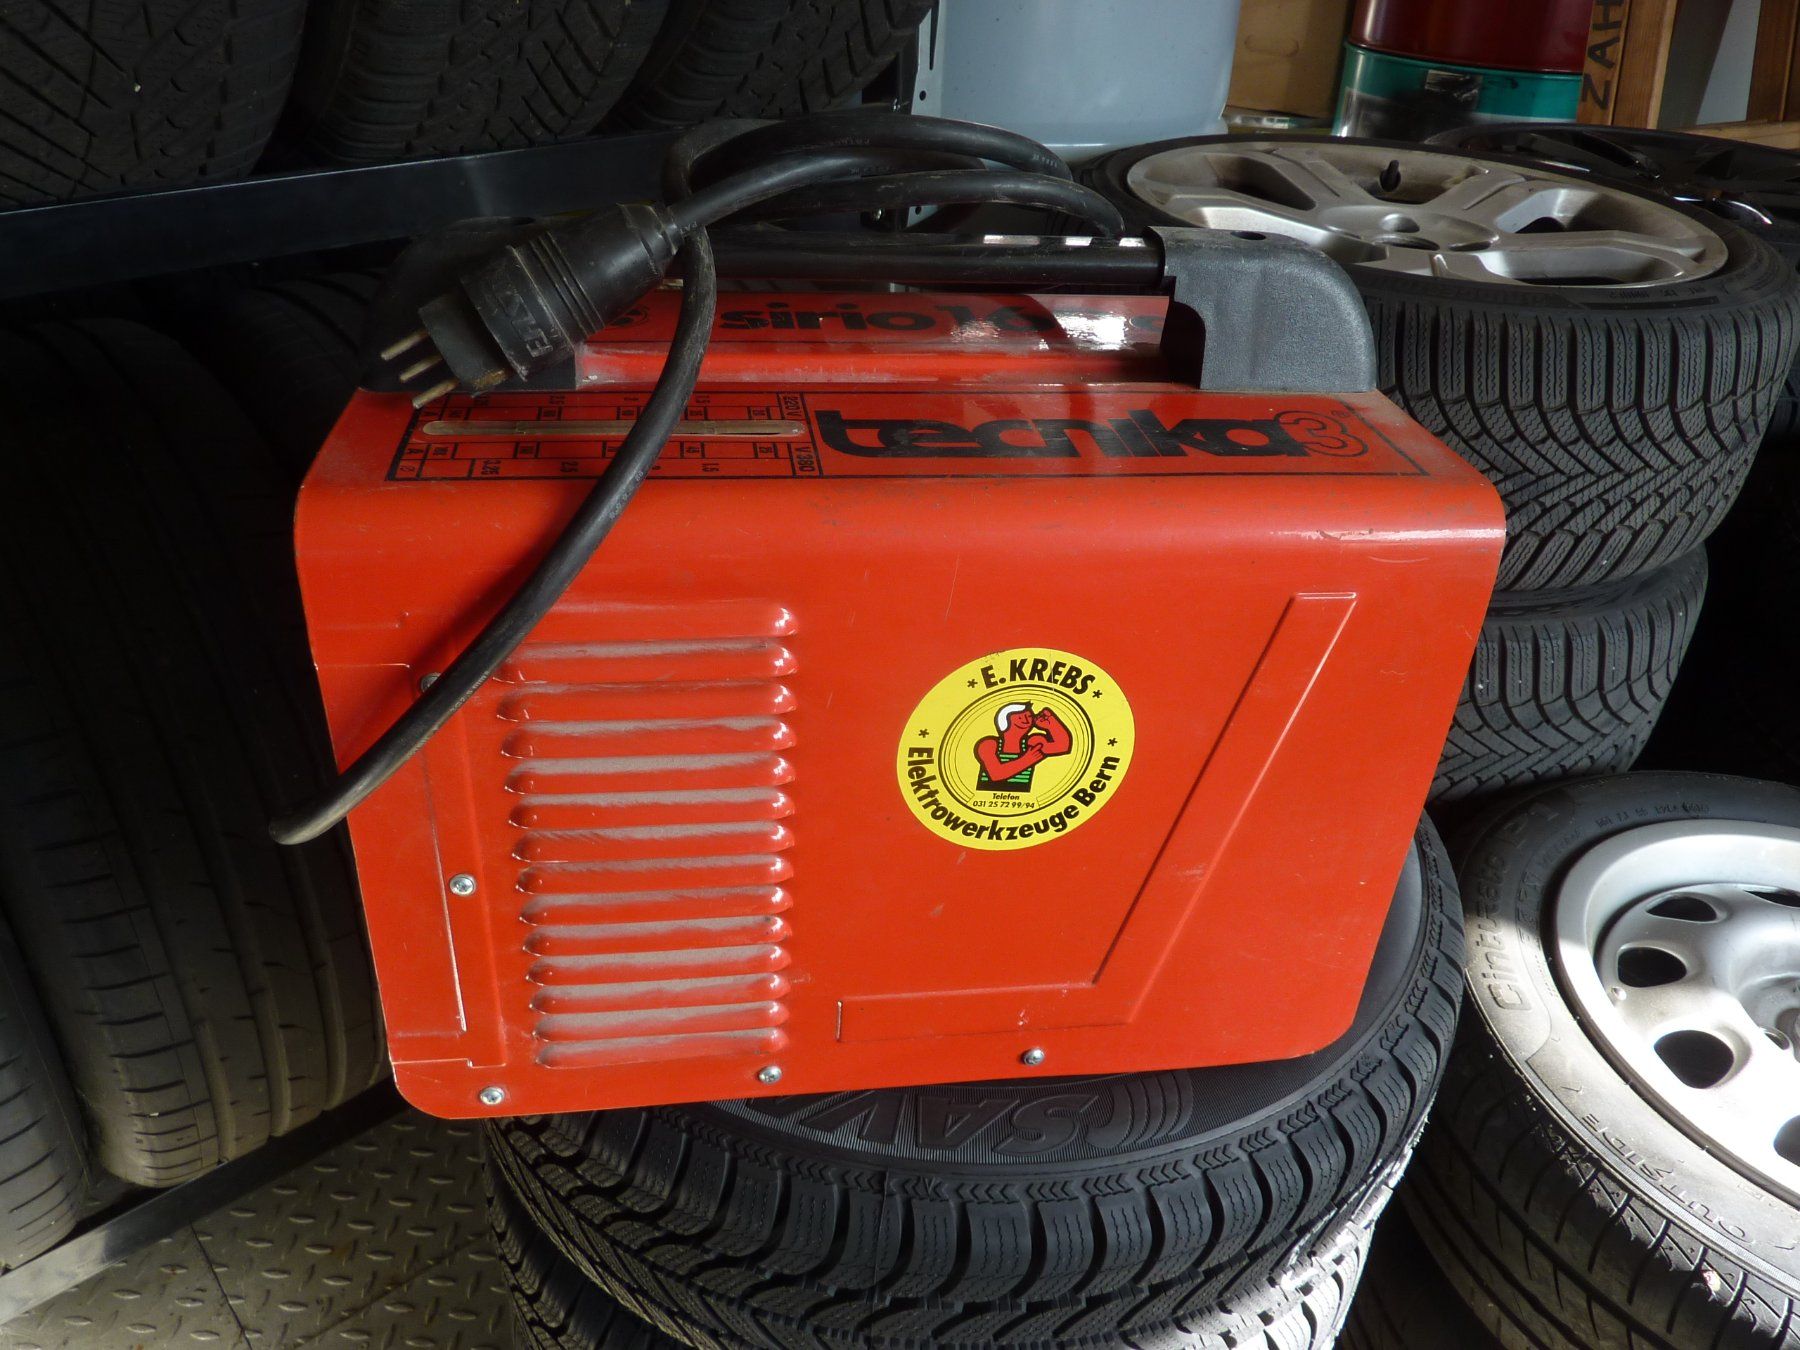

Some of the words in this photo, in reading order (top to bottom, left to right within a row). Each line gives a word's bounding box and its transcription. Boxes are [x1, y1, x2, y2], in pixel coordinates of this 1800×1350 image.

[720, 302, 921, 331] sirio
[907, 746, 1080, 841] Elektrowerkzeuge
[1071, 754, 1121, 808] Bern
[992, 792, 1021, 801] Telefon
[972, 800, 987, 808] 031
